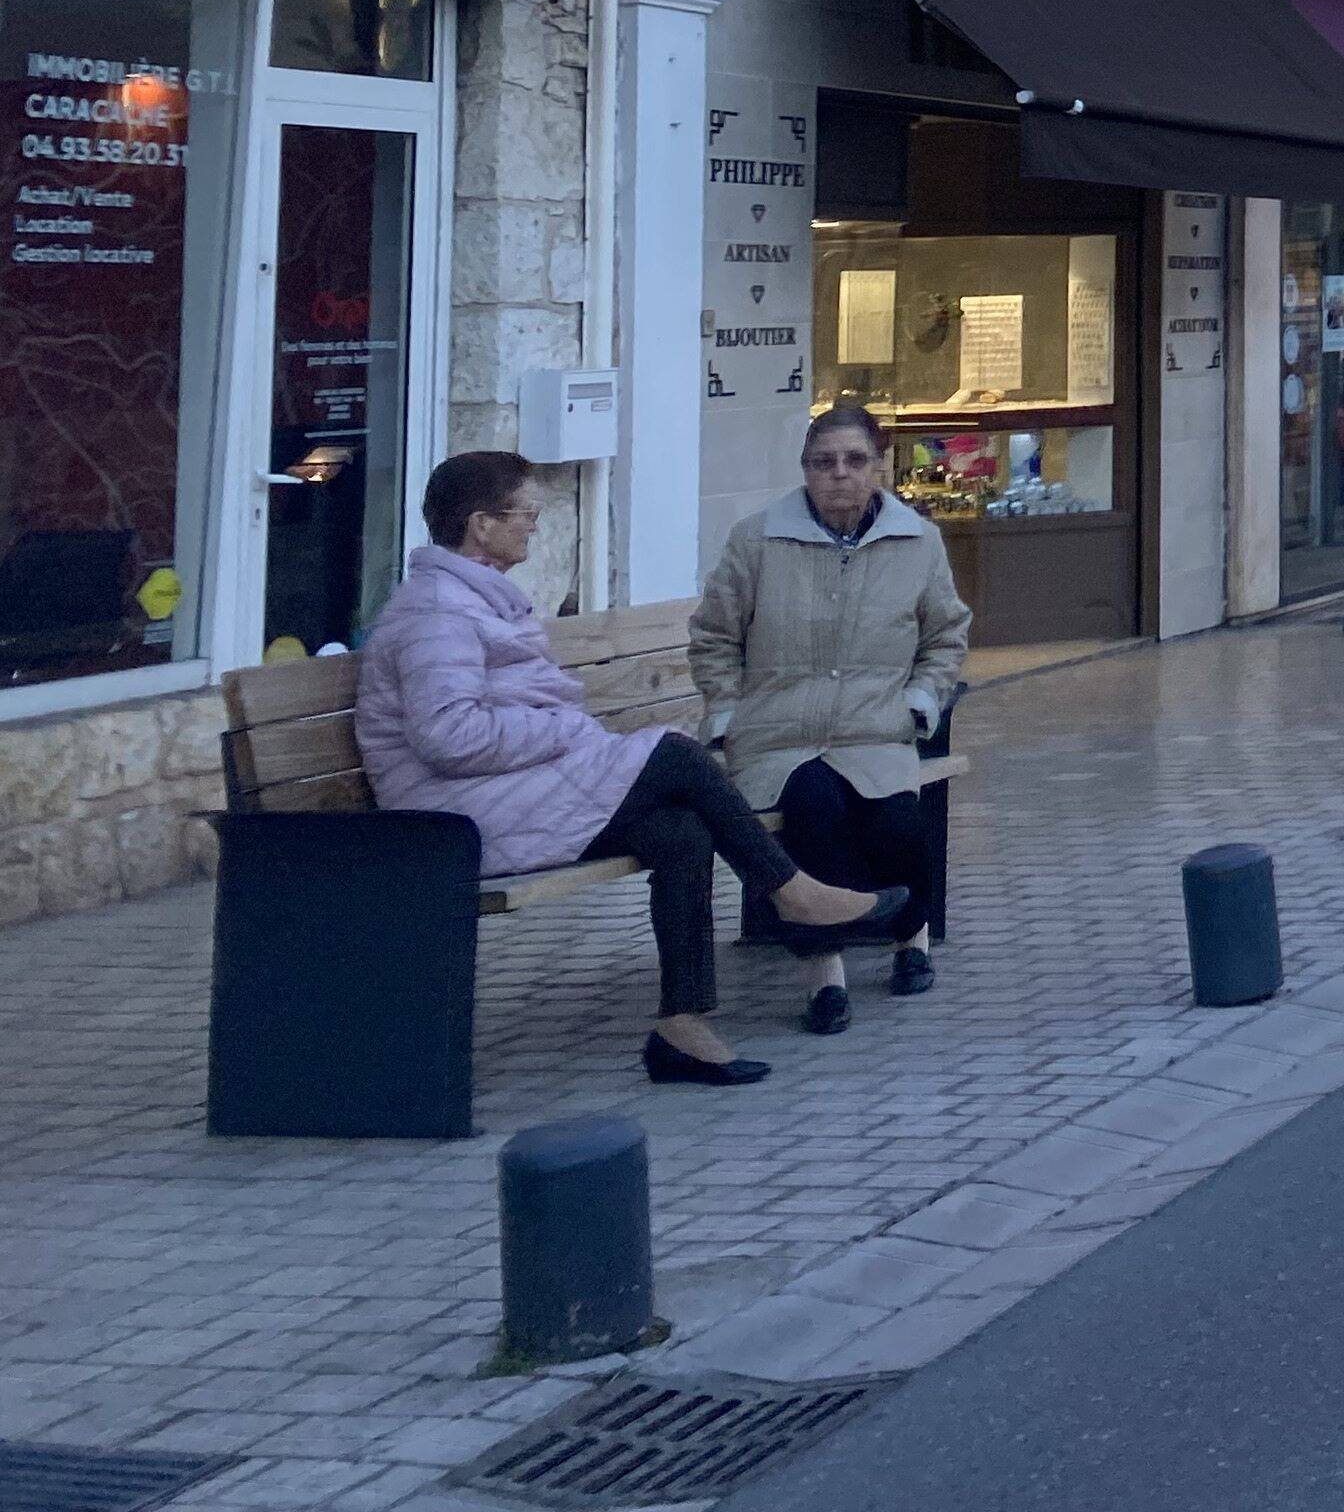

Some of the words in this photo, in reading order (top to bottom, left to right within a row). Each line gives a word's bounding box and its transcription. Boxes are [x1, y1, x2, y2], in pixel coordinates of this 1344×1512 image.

[709, 158, 805, 188] PHILIPPE
[723, 244, 792, 263] ARTISAN
[715, 327, 797, 348] BIJOUTIER
